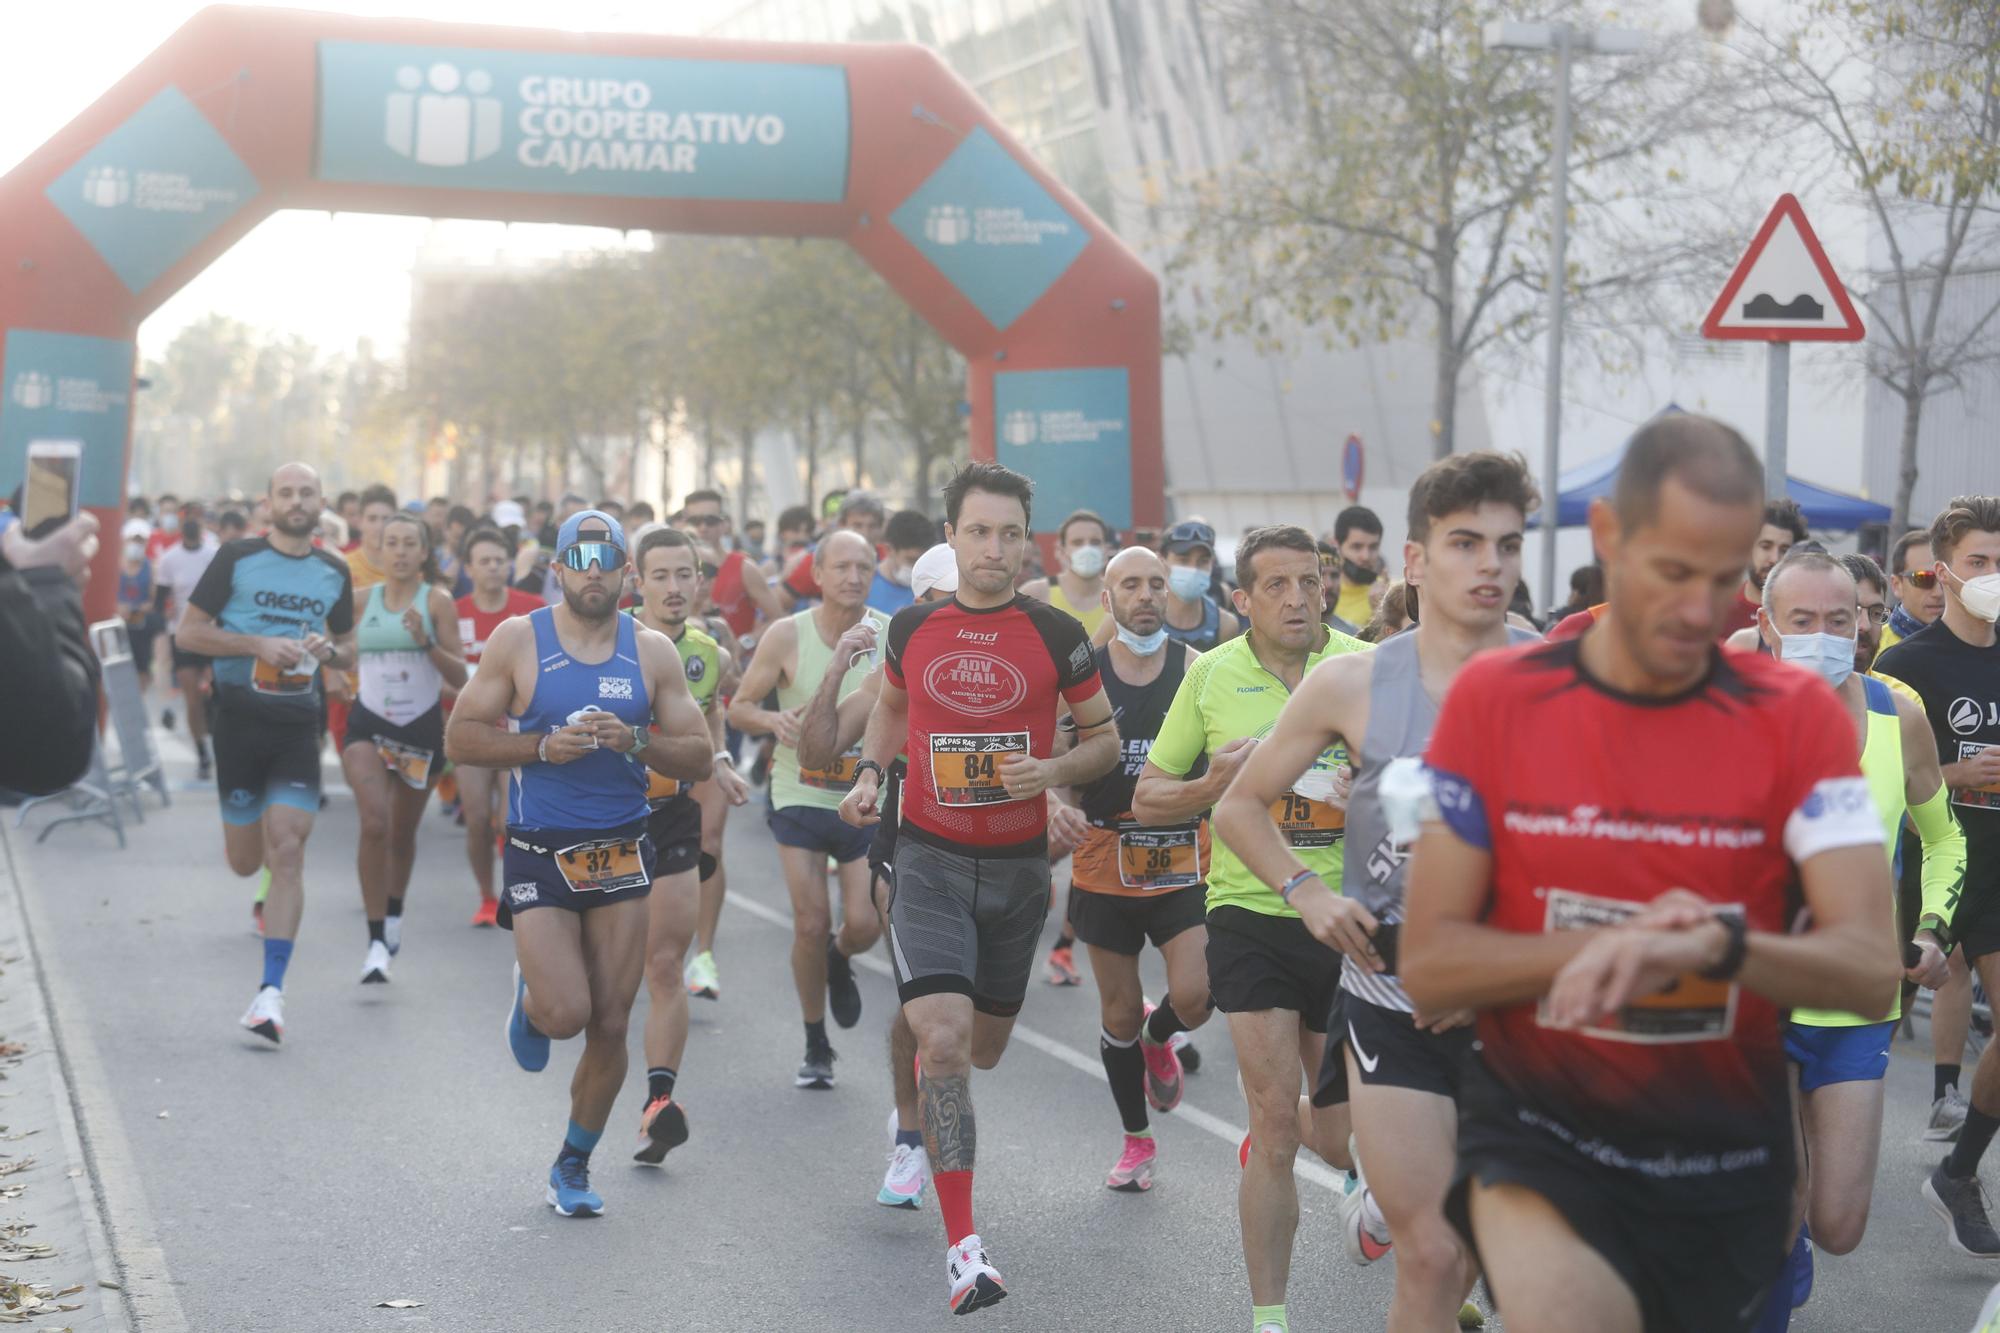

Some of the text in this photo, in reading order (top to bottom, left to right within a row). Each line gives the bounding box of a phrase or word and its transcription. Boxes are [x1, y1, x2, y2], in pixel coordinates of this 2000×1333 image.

[518, 76, 651, 109] GRUPO
[519, 106, 784, 145] COOPERATIVO
[517, 138, 698, 174] CAJAMAR
[254, 590, 325, 617] CRESPO
[956, 628, 998, 642] land
[950, 668, 998, 686] TRAIL
[957, 658, 992, 673] ADV
[1987, 702, 2000, 726] J
[934, 736, 948, 748] 10K
[948, 738, 961, 746] PAS
[962, 739, 977, 747] RAS
[1962, 745, 1976, 755] 10K
[964, 754, 995, 780] 84
[1281, 795, 1311, 821] 75
[586, 849, 612, 873] 32
[1146, 848, 1171, 870] 36
